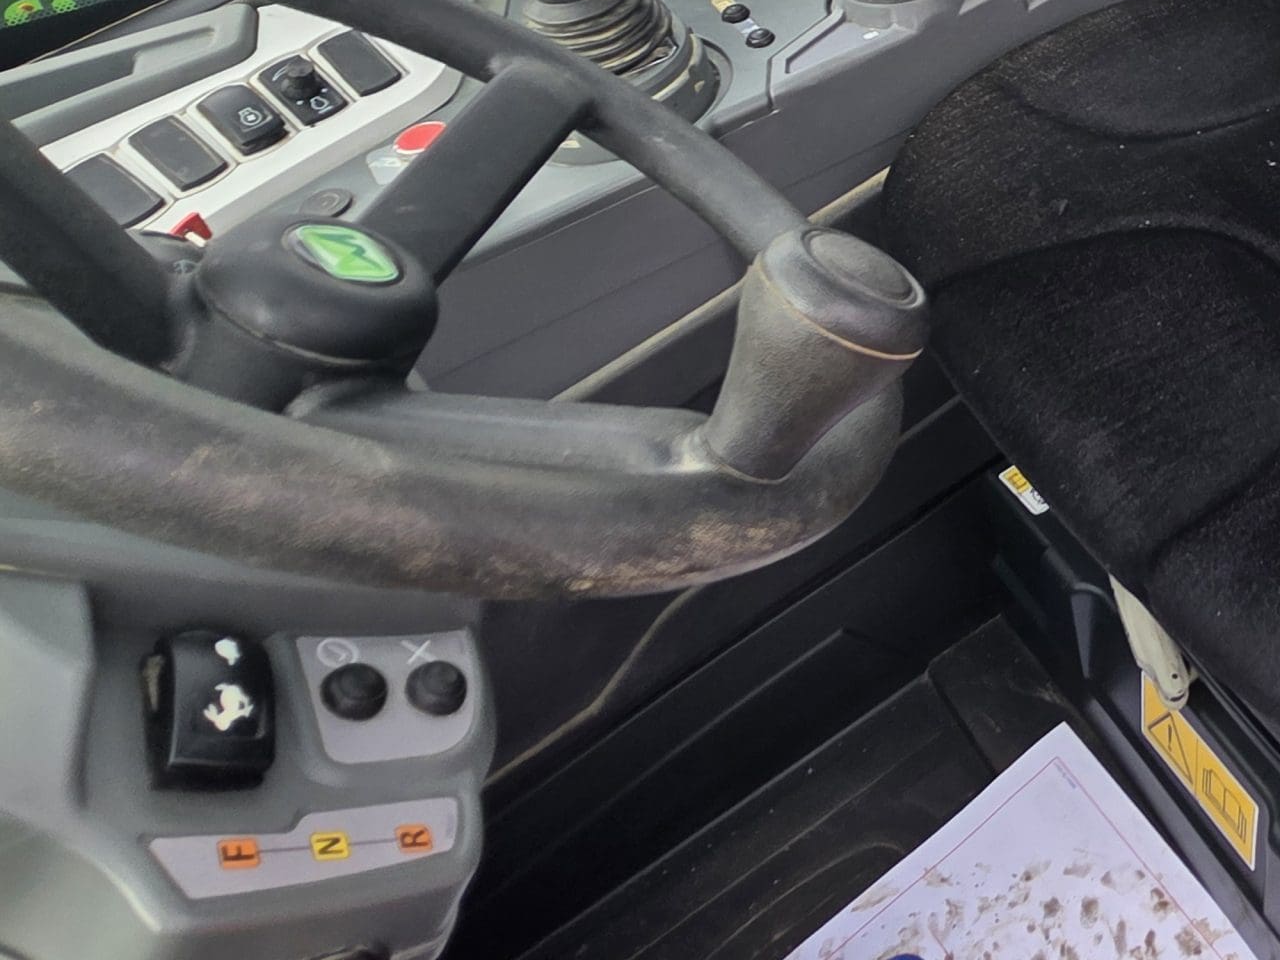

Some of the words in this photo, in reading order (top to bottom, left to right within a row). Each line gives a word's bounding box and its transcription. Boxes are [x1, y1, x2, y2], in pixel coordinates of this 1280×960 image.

[221, 844, 255, 861] F
[315, 837, 345, 855] N
[400, 829, 429, 848] R
